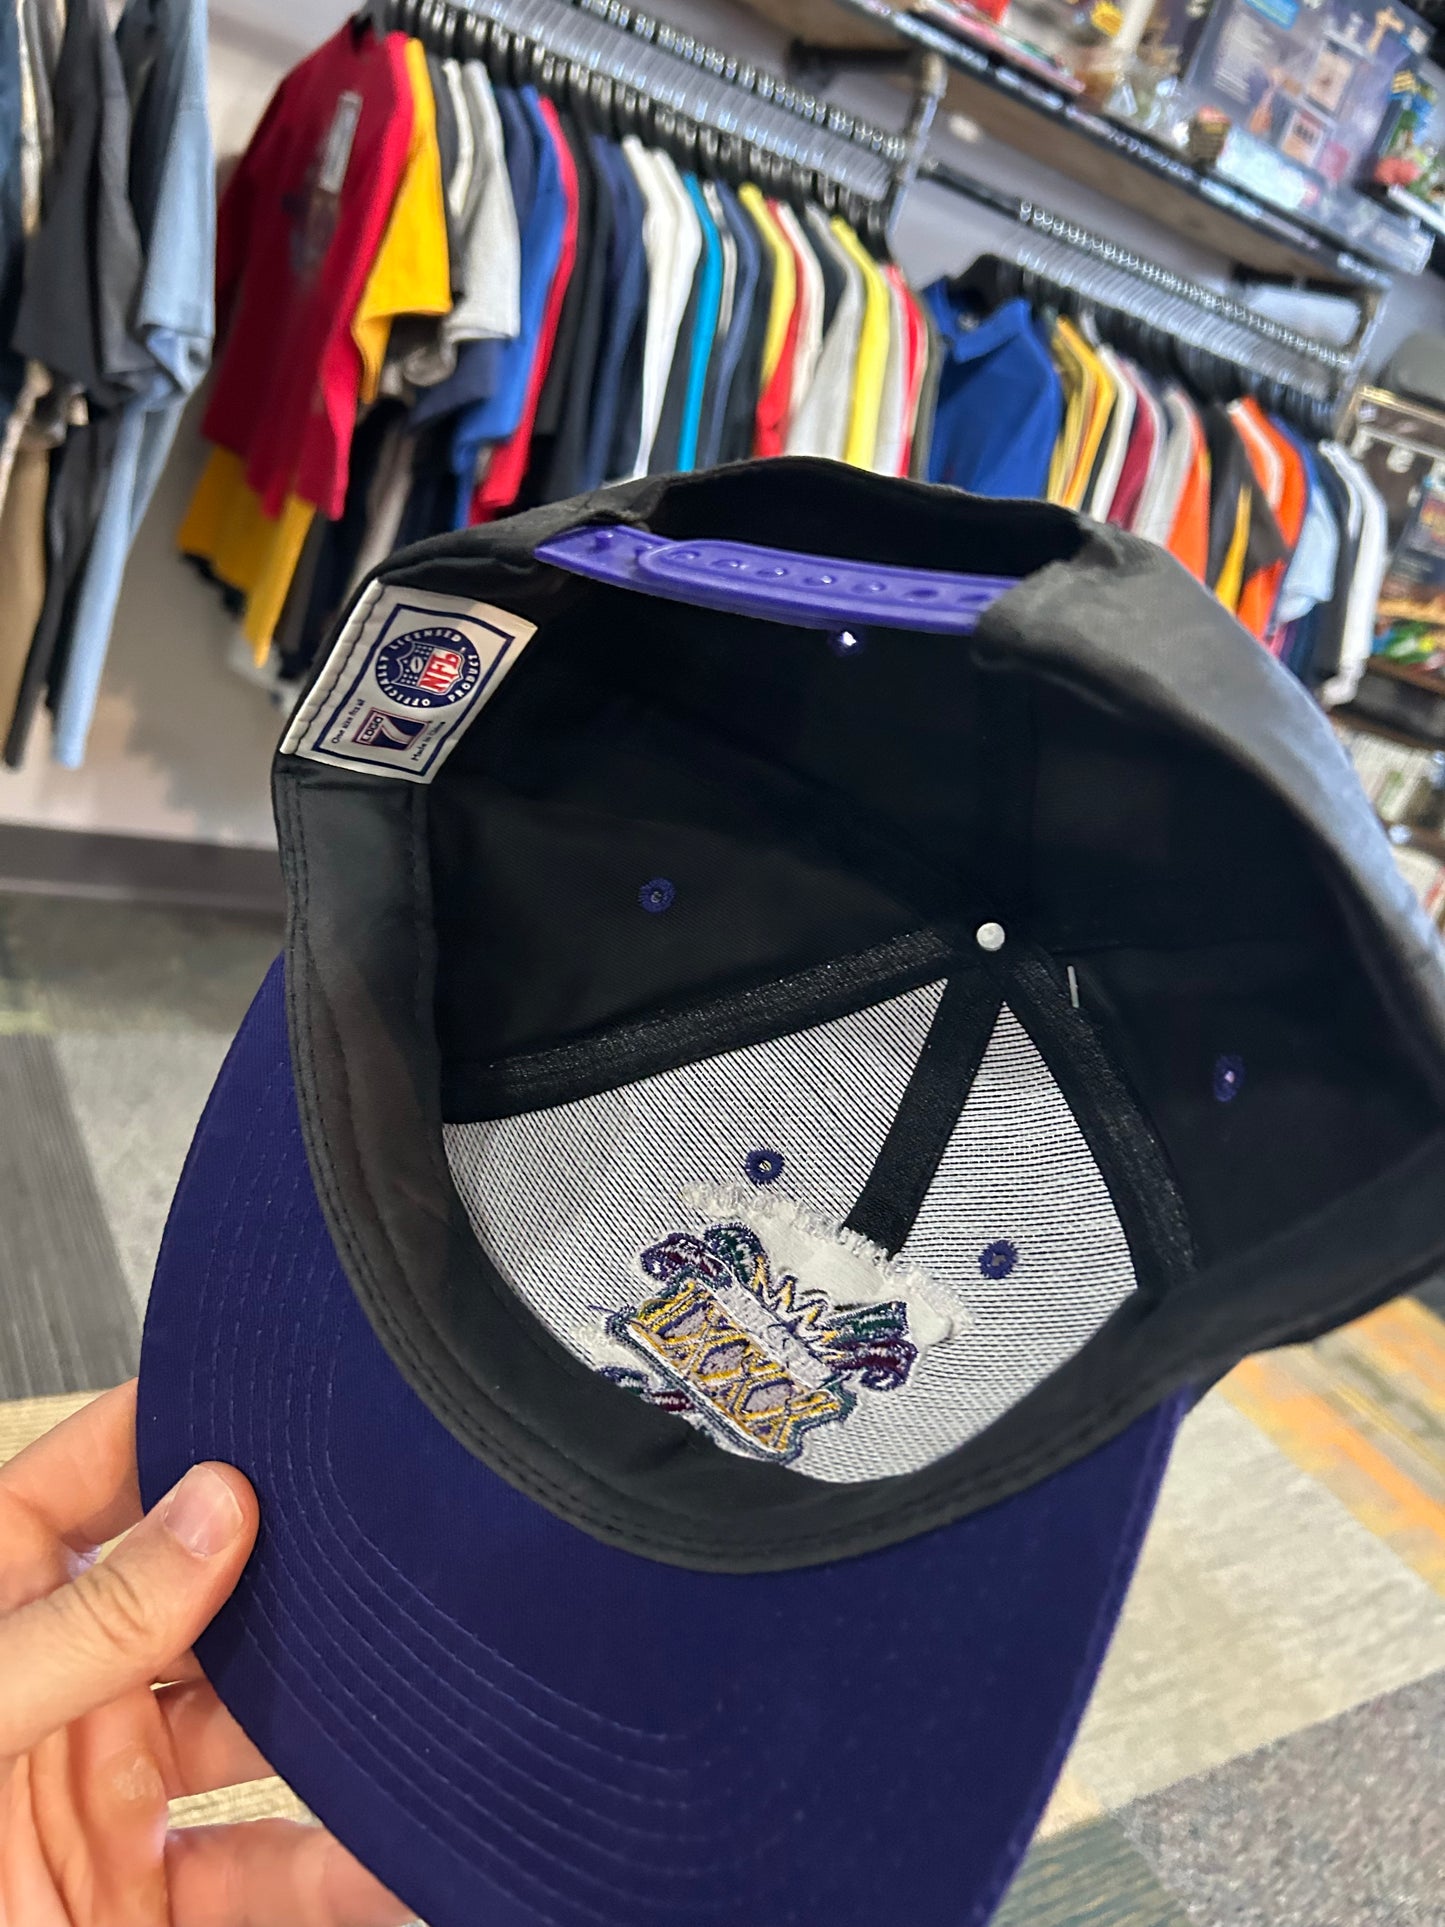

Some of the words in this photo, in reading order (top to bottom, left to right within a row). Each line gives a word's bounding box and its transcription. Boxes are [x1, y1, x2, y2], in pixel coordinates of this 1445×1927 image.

[389, 630, 462, 650] LICENSED
[378, 656, 431, 706] OFFICIALLY
[418, 650, 461, 693] NFL
[447, 655, 479, 702] PRODUCT
[331, 729, 344, 744] One
[362, 716, 384, 742] LOGO
[411, 742, 427, 761] Made
